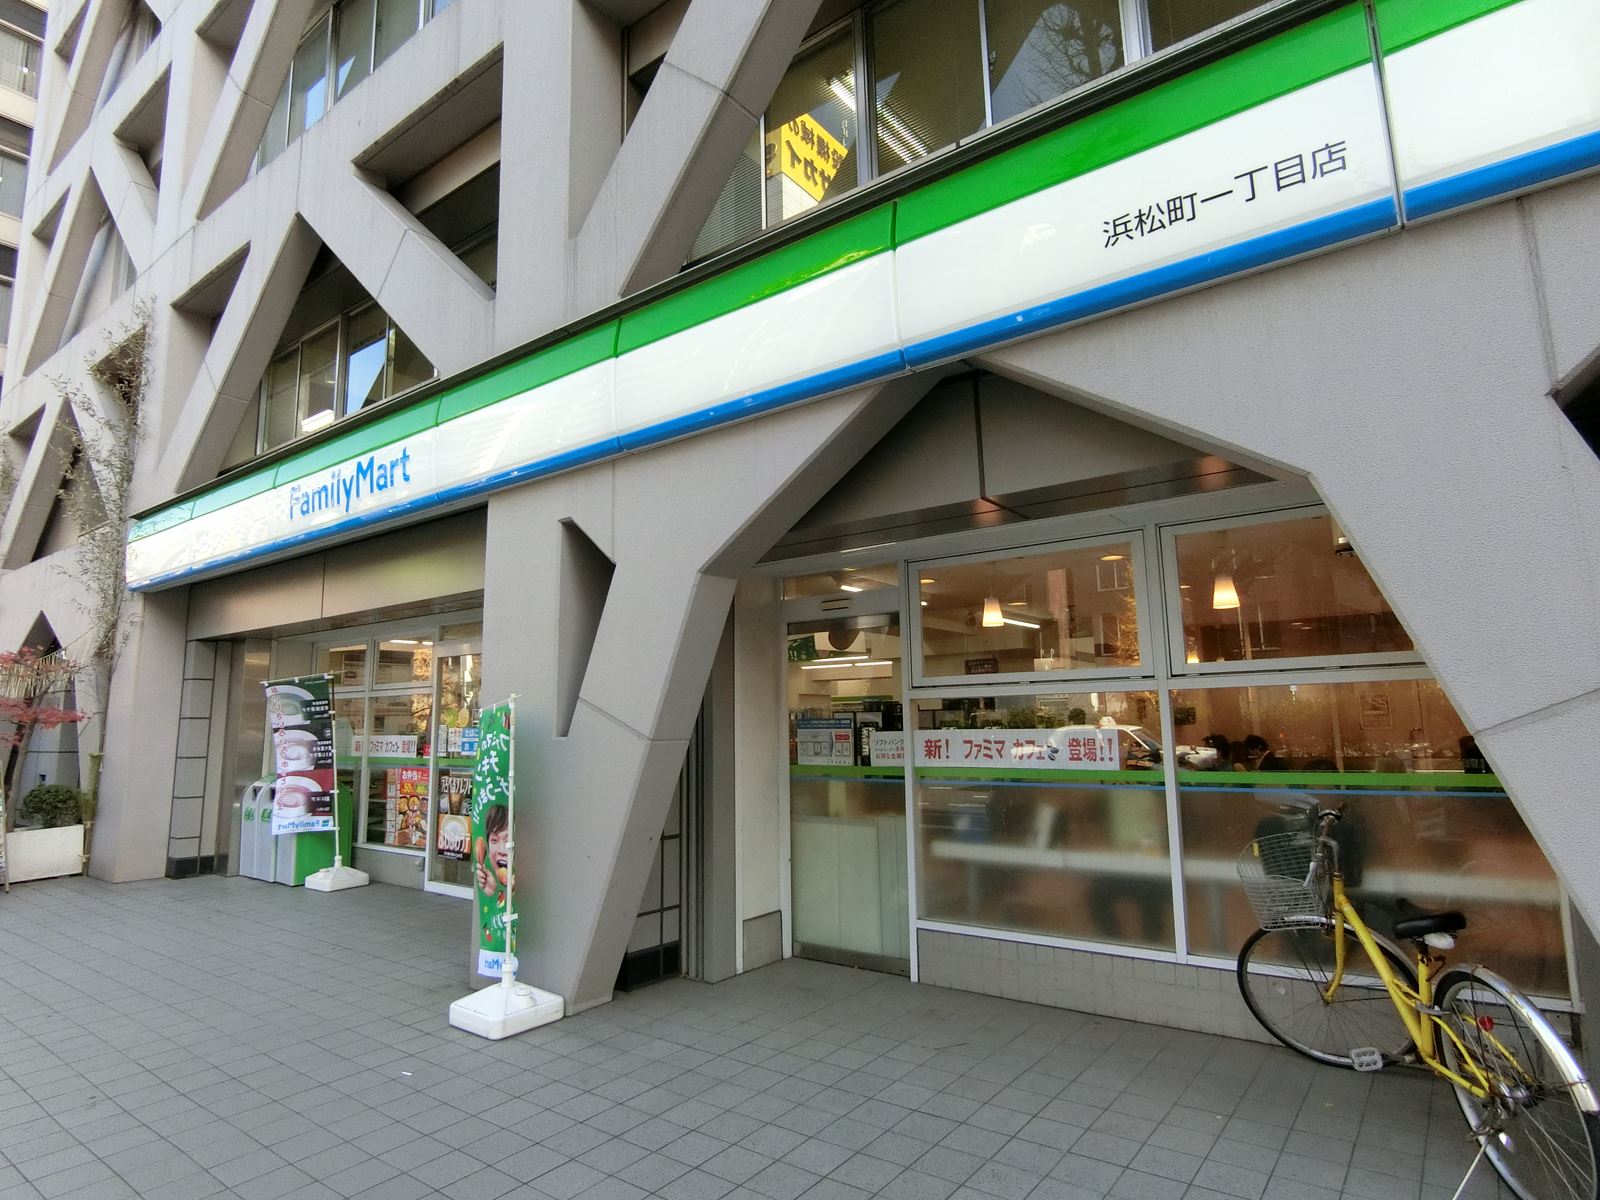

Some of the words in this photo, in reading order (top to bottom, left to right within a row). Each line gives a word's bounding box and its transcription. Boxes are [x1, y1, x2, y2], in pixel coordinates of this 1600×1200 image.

[1103, 140, 1347, 248] 浜松町一丁目店
[289, 446, 411, 520] FamilyMart
[924, 738, 951, 760] 新!
[962, 738, 1005, 760] ファミマ
[1012, 739, 1047, 761] カフェ
[1067, 738, 1114, 763] 登場!!
